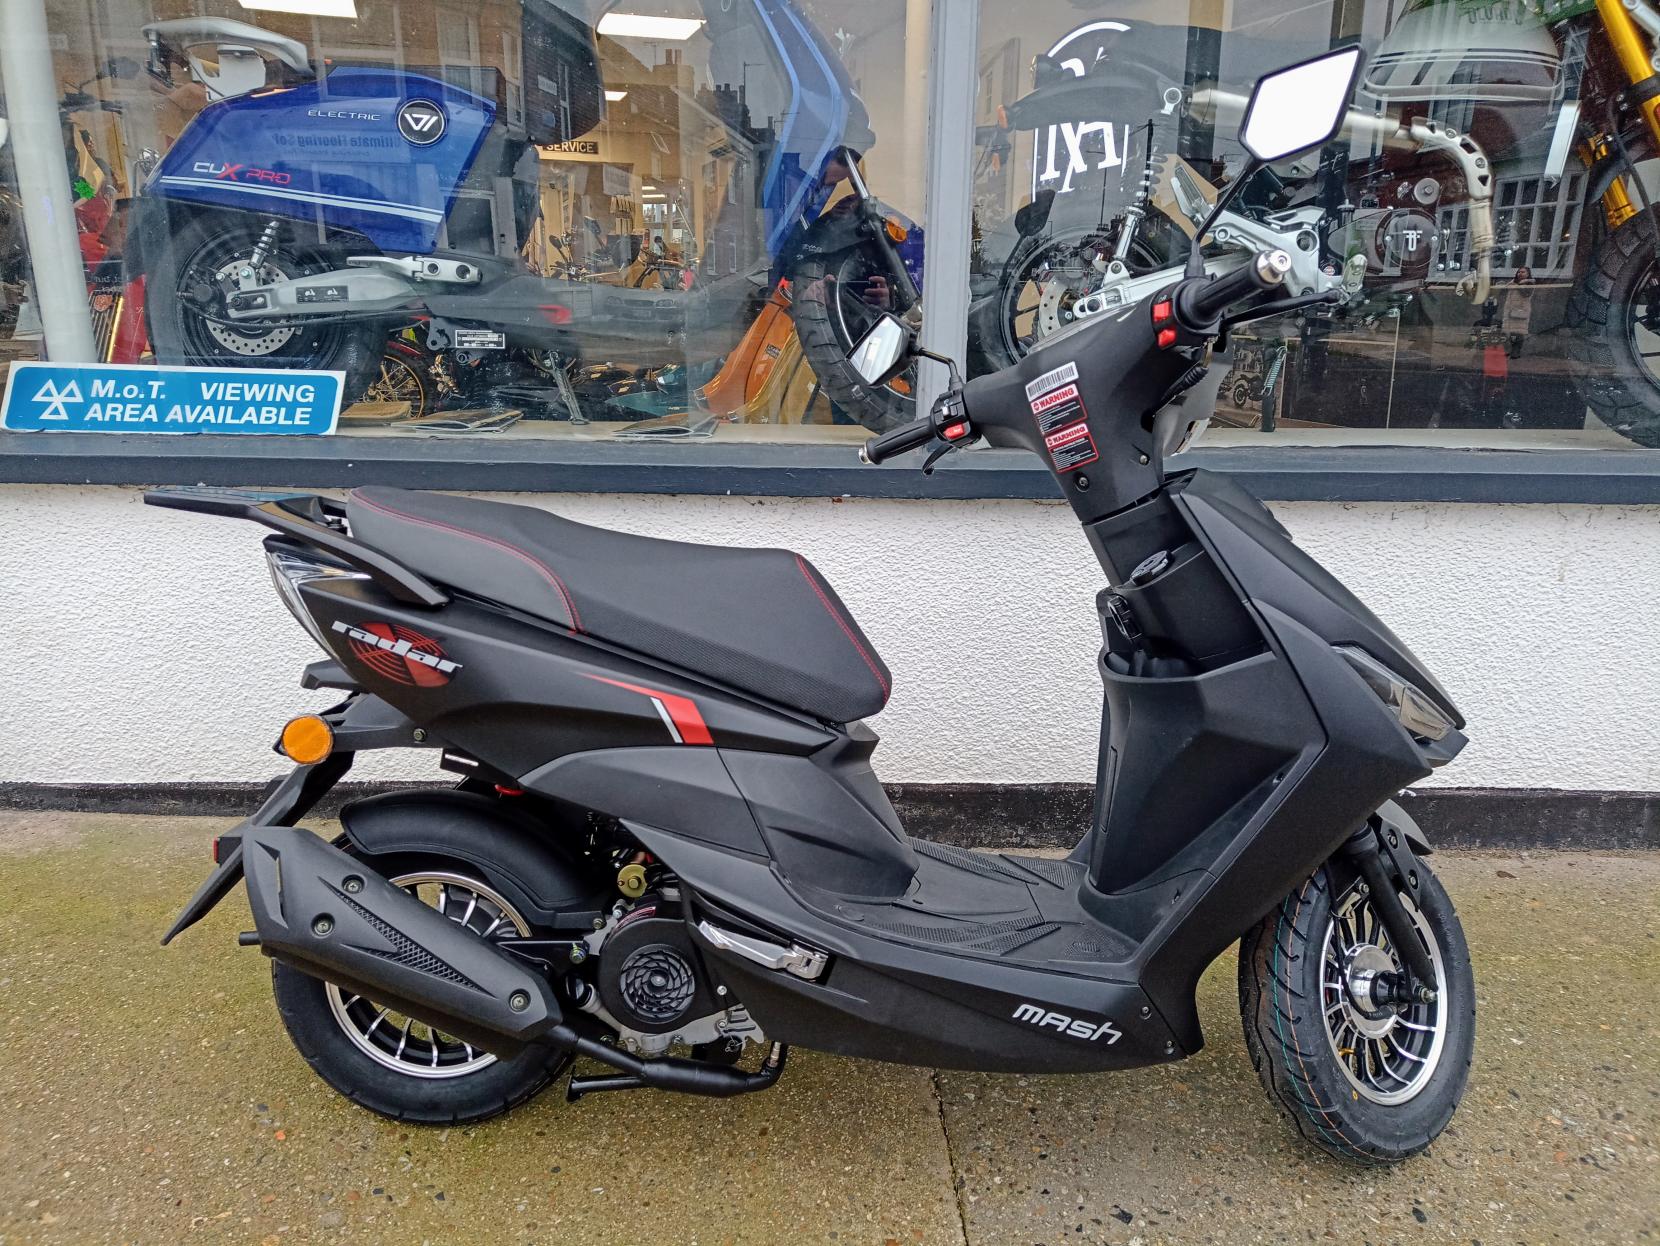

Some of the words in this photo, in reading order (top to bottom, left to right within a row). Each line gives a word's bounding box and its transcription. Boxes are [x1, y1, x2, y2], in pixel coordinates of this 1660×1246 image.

[308, 109, 381, 121] ELECTRIC
[547, 142, 594, 152] SERVICE
[193, 162, 244, 180] CUX
[246, 168, 290, 184] PRO
[90, 379, 166, 399] M.o.T.
[201, 382, 315, 403] VIEWING
[1039, 387, 1075, 408] WARNING
[84, 403, 158, 423] AREA
[164, 405, 312, 425] AVAILABLE
[1053, 426, 1085, 444] WARNING
[331, 620, 463, 673] radar
